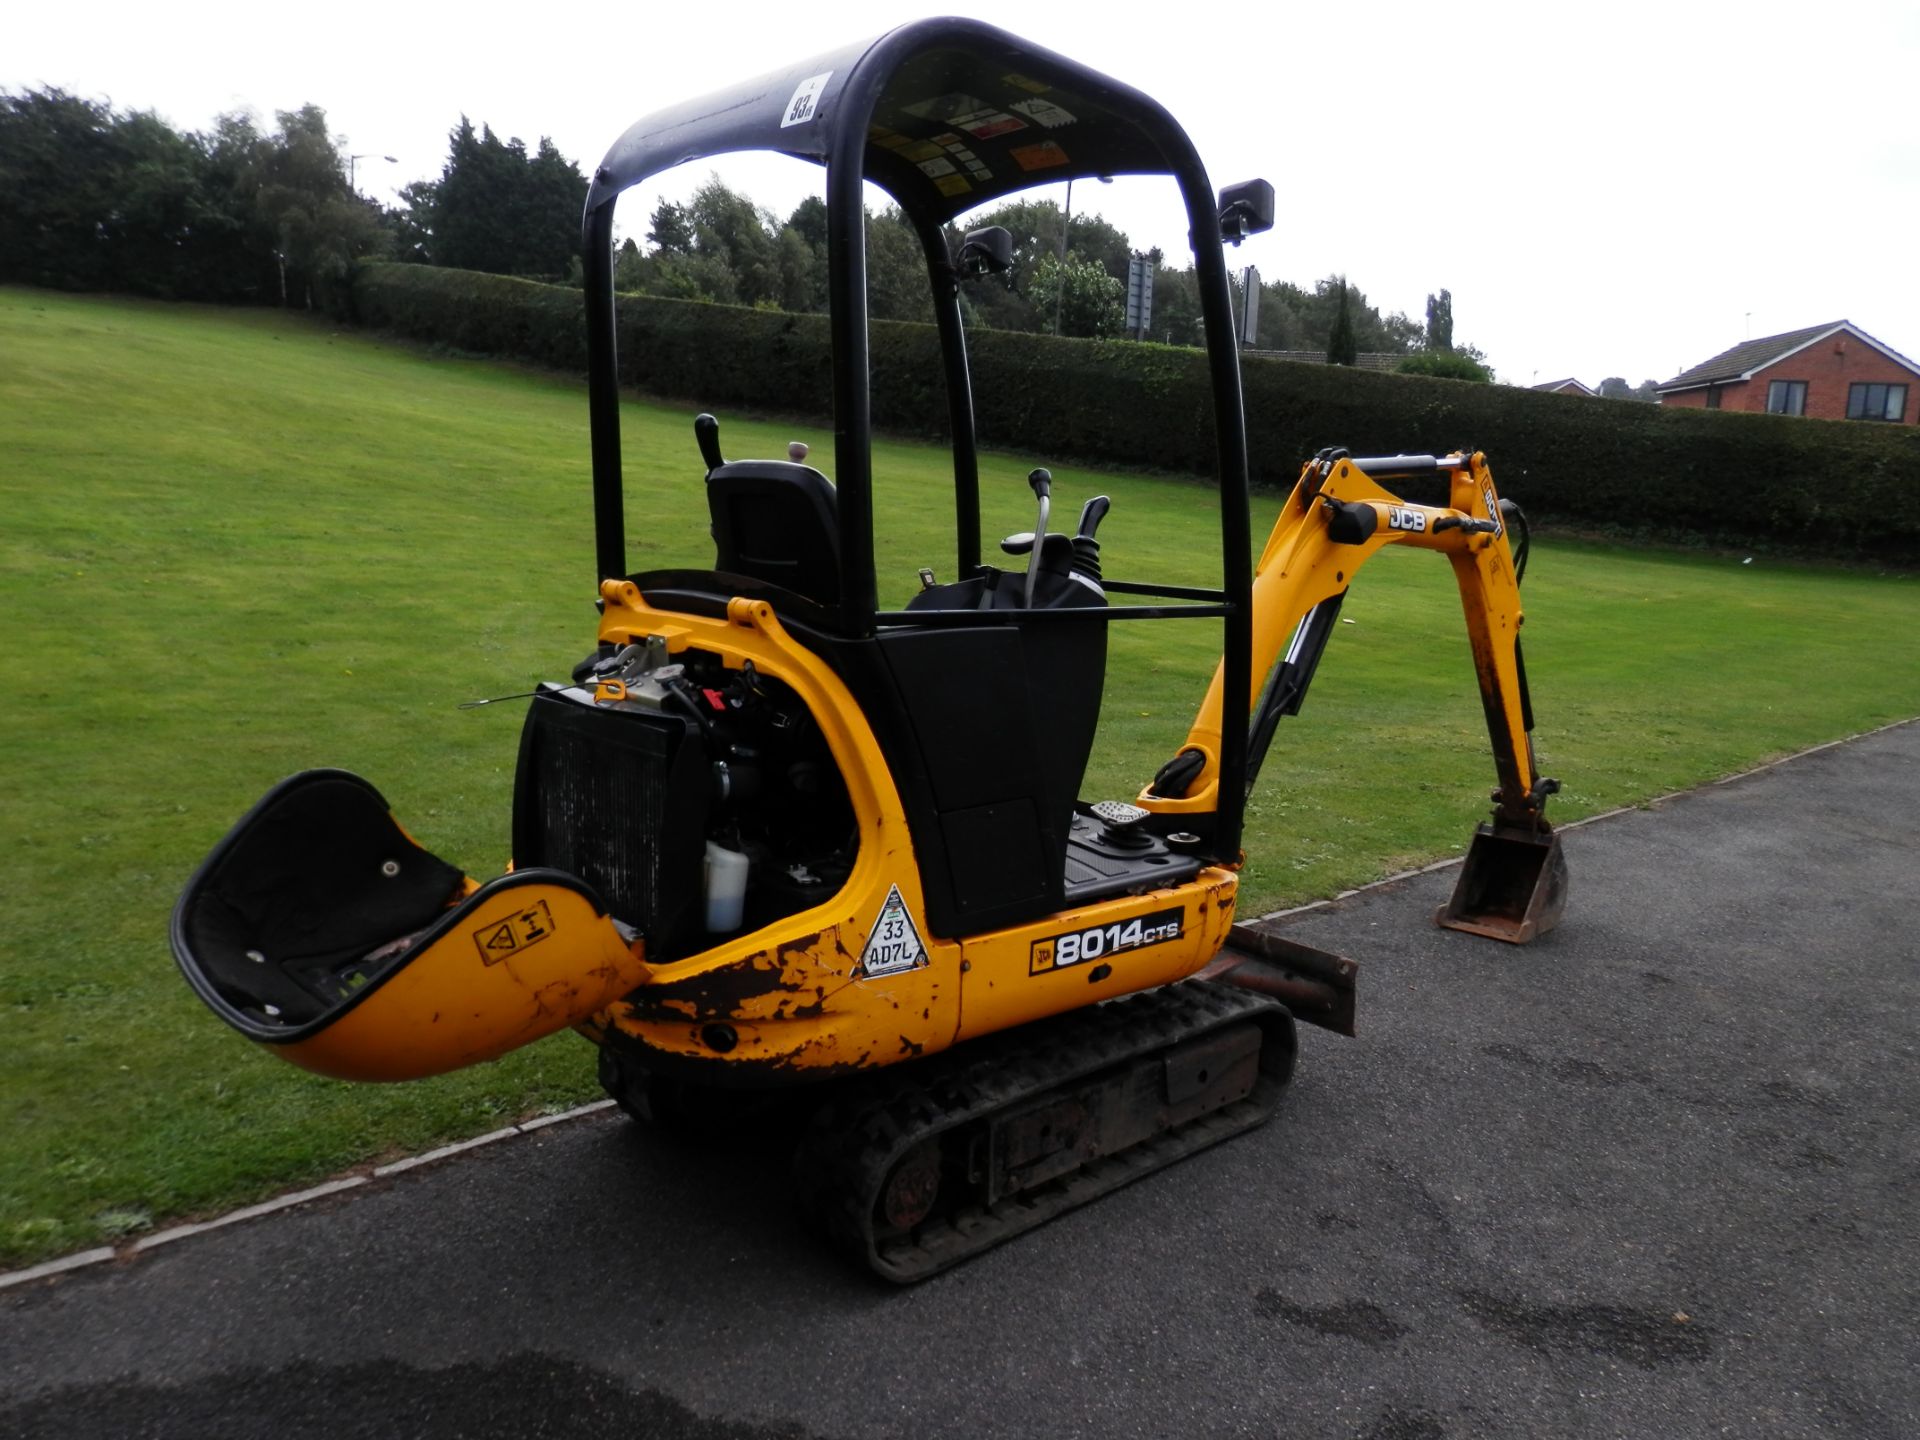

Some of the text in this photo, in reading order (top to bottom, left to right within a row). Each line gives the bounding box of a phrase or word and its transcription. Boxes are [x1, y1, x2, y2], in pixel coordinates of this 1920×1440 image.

[789, 94, 811, 121] 93
[1390, 508, 1425, 531] JCB
[883, 920, 904, 941] 33
[869, 942, 912, 966] AD7L
